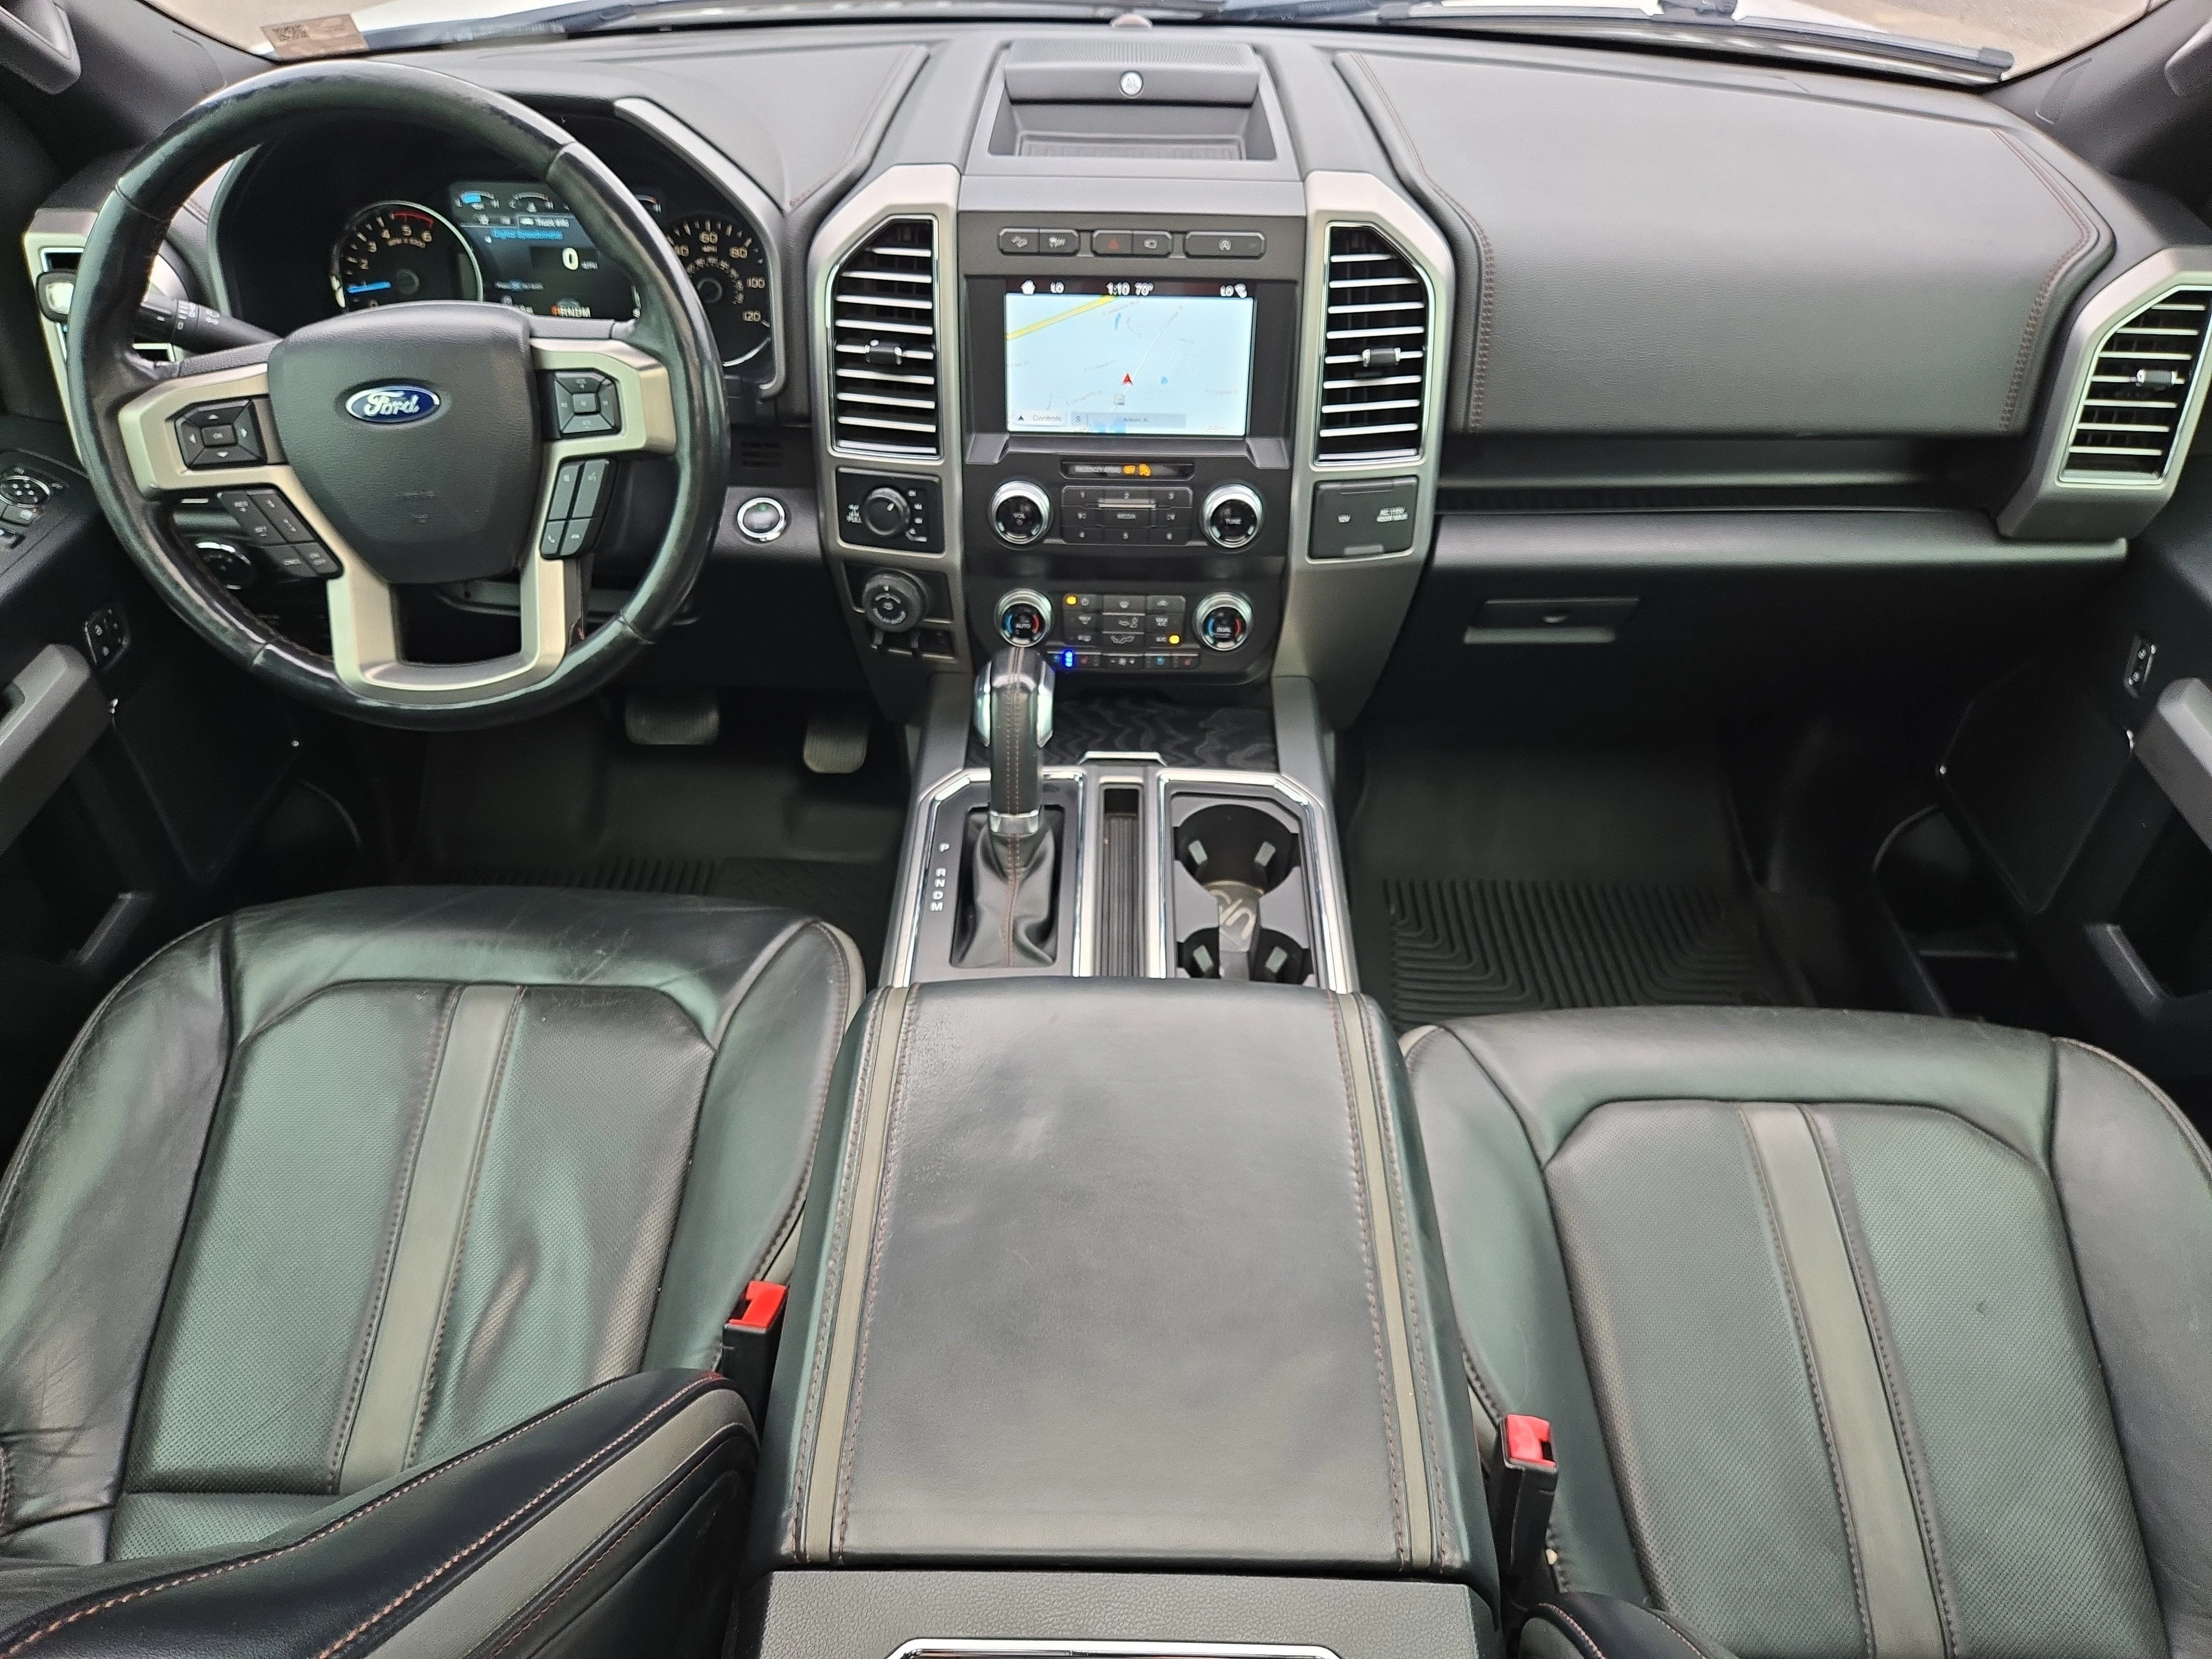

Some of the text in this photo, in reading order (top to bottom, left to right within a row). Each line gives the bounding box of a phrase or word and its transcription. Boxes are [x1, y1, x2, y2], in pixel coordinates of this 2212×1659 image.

[381, 229, 390, 239] 4
[402, 225, 412, 236] 5
[421, 230, 432, 242] 6
[699, 231, 718, 244] 60
[368, 241, 377, 253] 3
[730, 246, 748, 259] 80
[360, 258, 368, 269] 2
[562, 247, 579, 270] 0
[747, 276, 766, 288] 100
[1051, 281, 1064, 293] LO
[1106, 281, 1130, 295] 1:10
[1220, 285, 1234, 297] LO
[742, 310, 761, 322] 120
[364, 390, 420, 417] Ford
[939, 843, 949, 852] P
[935, 867, 946, 877] R
[934, 878, 945, 888] N
[932, 890, 944, 900] D
[930, 902, 943, 911] M
